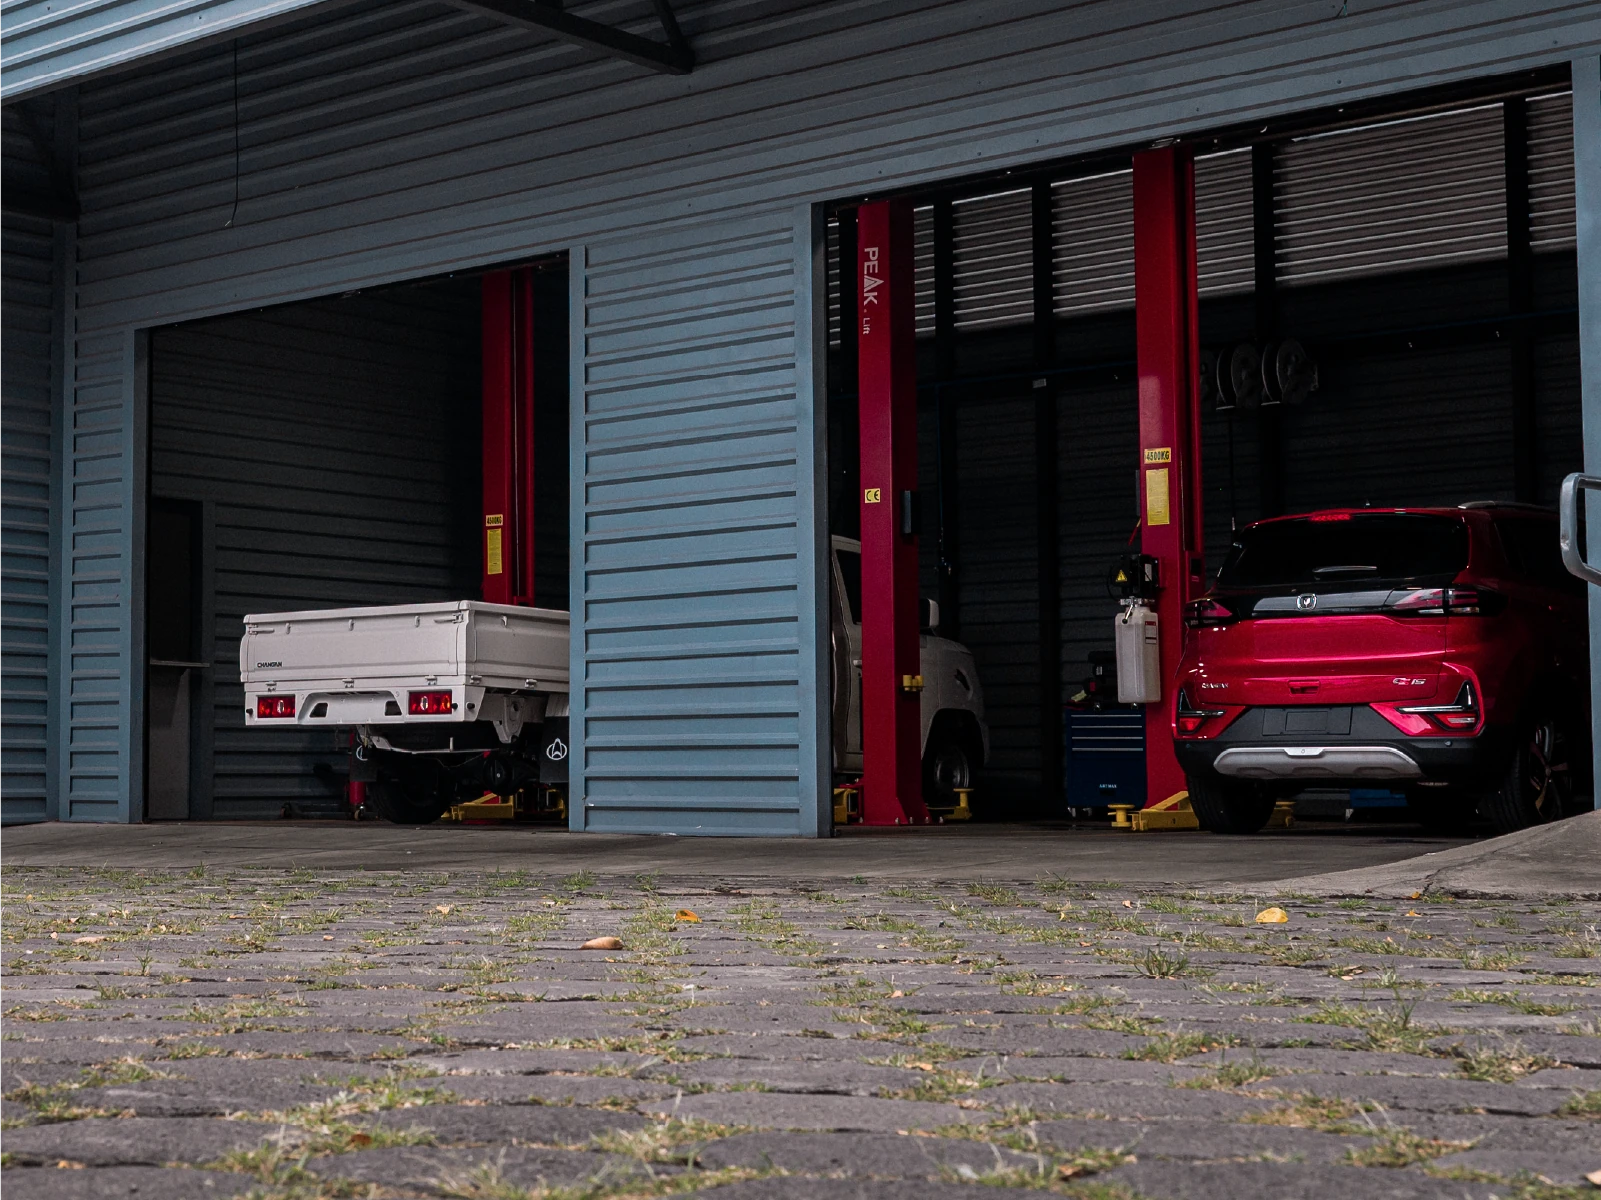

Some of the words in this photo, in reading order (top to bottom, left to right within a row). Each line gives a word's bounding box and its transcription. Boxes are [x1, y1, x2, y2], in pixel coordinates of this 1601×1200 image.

[863, 246, 885, 306] PEAK
[1146, 450, 1170, 462] 4500KG
[866, 489, 880, 502] CE
